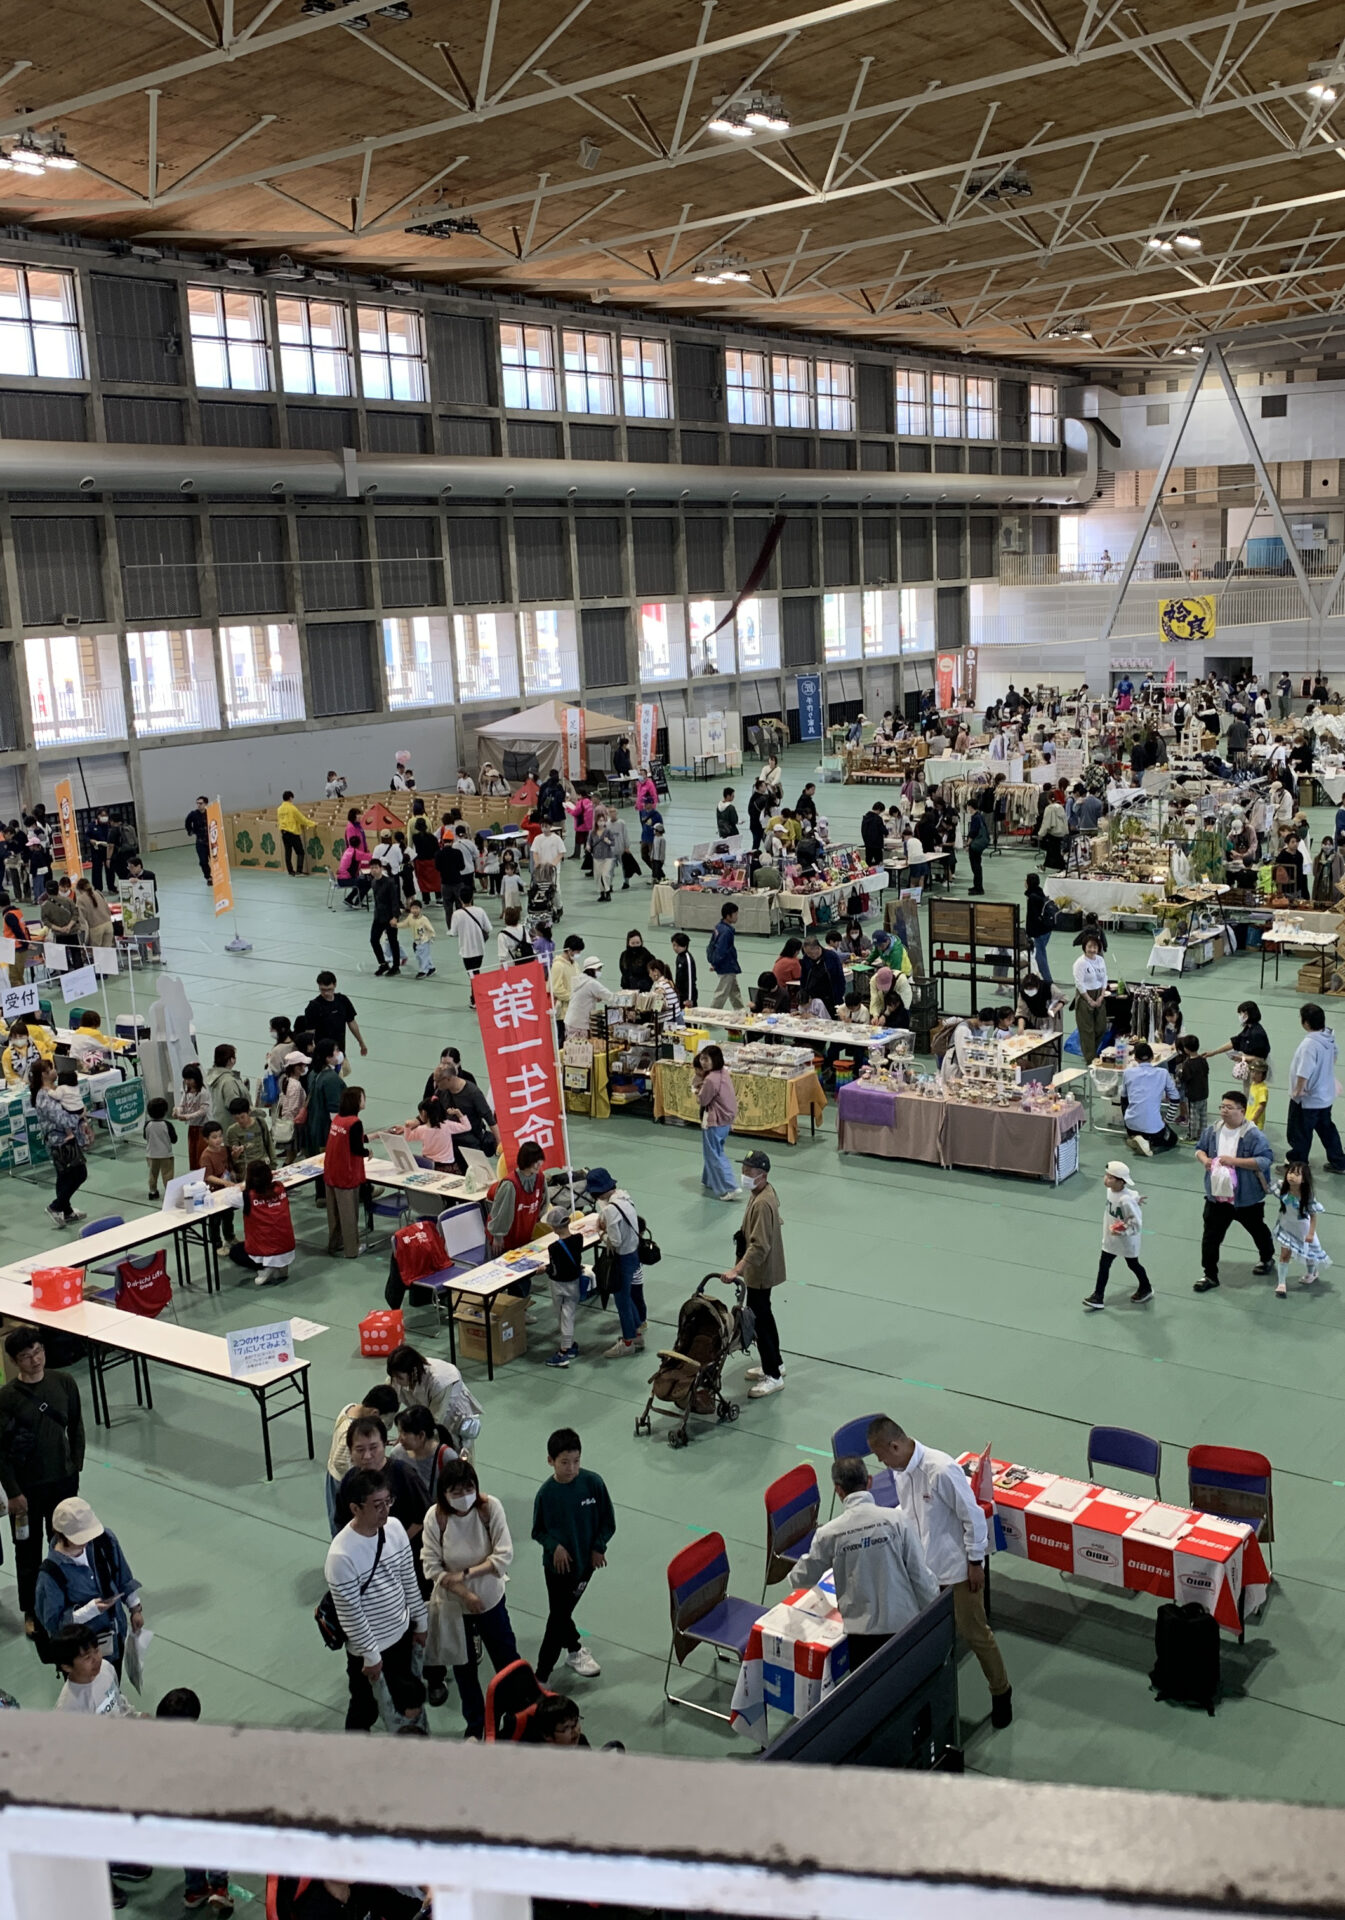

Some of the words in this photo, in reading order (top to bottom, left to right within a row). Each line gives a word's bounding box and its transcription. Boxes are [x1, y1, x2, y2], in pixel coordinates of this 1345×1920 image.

[1164, 602, 1209, 637] 姶良
[5, 989, 36, 1011] 受付
[126, 1275, 151, 1289] Dai-ichi
